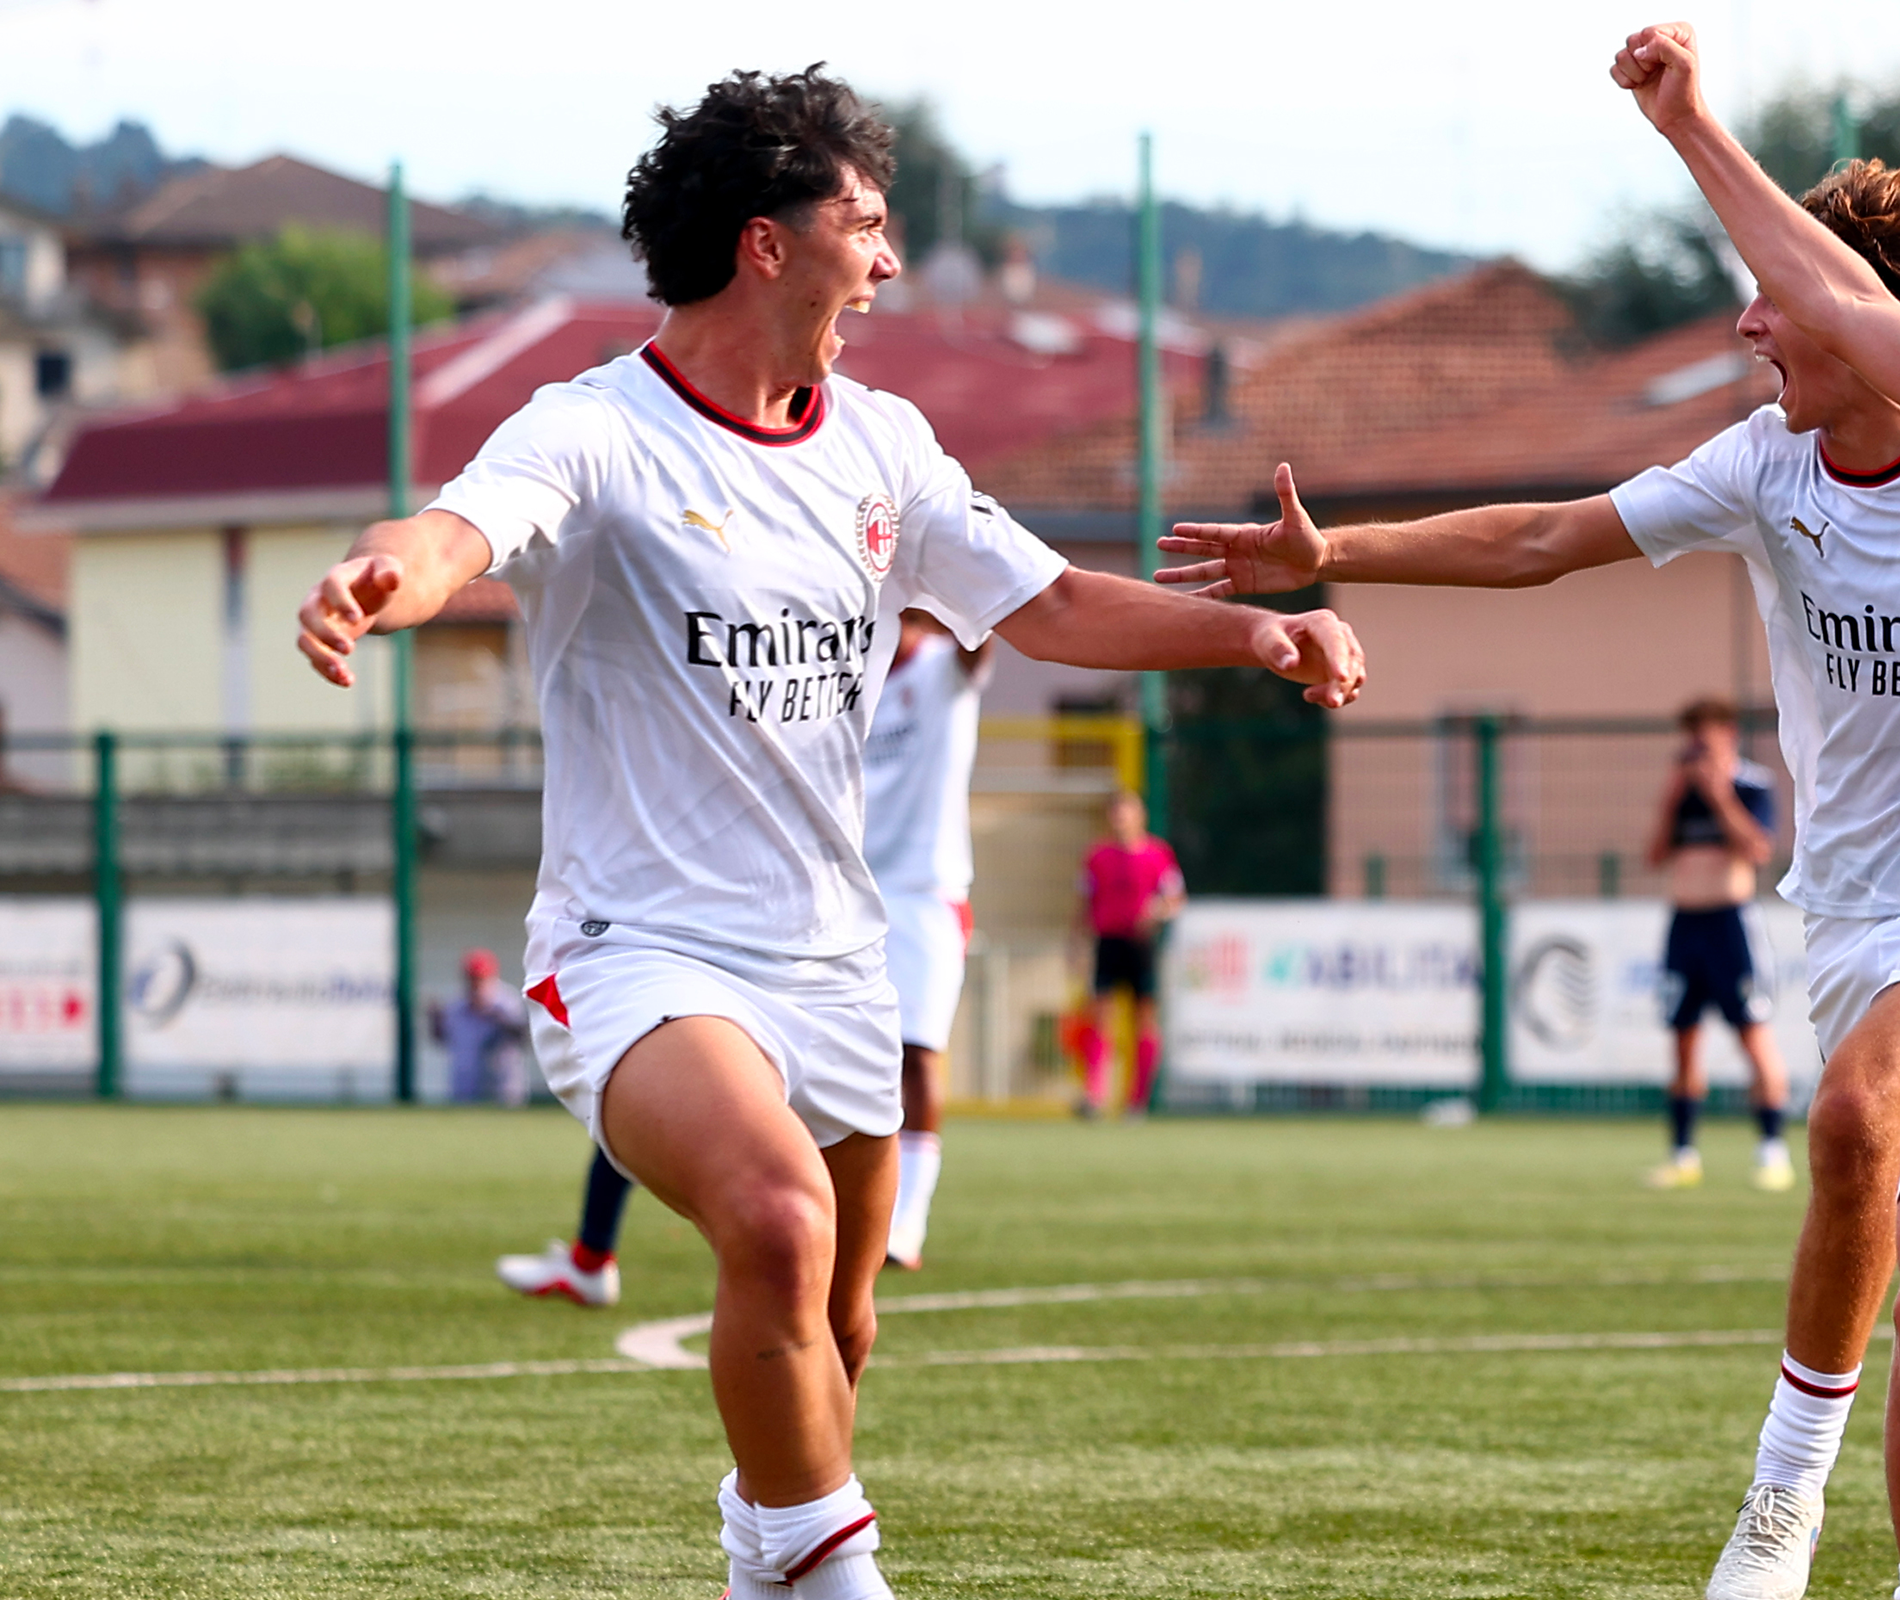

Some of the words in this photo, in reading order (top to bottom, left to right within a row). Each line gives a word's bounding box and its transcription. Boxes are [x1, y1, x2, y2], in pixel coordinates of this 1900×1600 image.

[1826, 652, 1861, 692] FLY
[729, 680, 774, 723] FLY
[781, 672, 862, 723] BETTER
